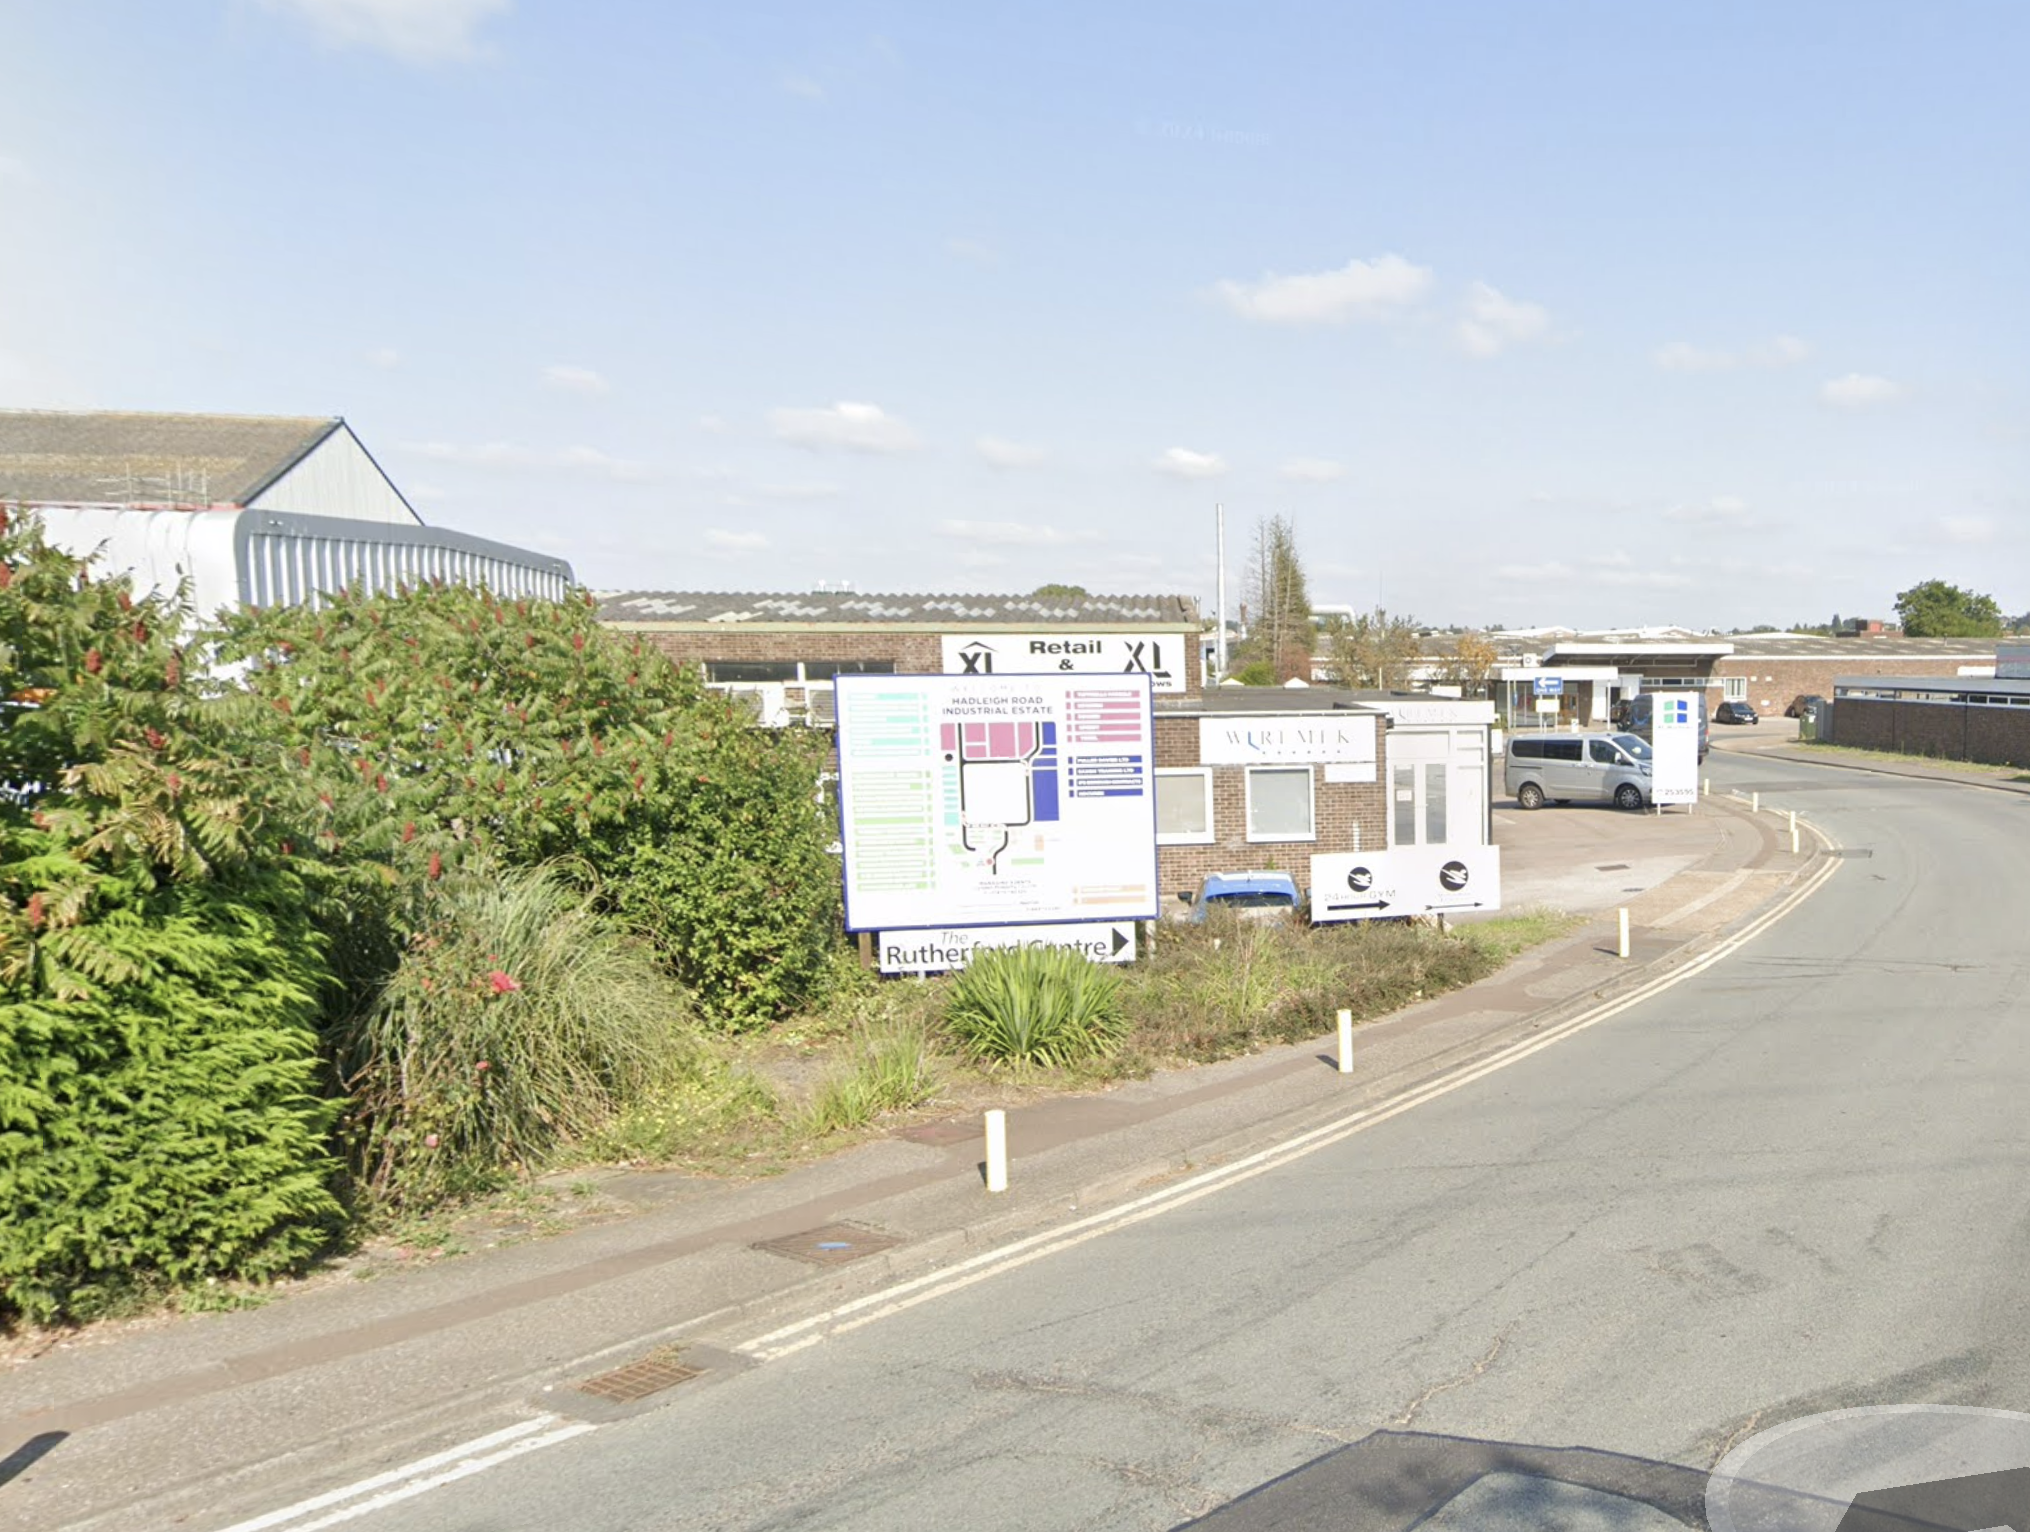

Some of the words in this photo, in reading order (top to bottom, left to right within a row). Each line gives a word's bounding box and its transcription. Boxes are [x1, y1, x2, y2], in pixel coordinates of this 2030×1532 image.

[1029, 640, 1102, 655] Retail
[1059, 659, 1074, 671] &
[1124, 641, 1172, 679] XL
[952, 696, 1009, 705] HADLEIGH
[1011, 696, 1043, 705] ROAD
[942, 706, 1009, 715] INDUSTRIAL
[1011, 706, 1053, 715] ESTATE
[1369, 889, 1396, 900] GYM
[941, 931, 968, 945] The
